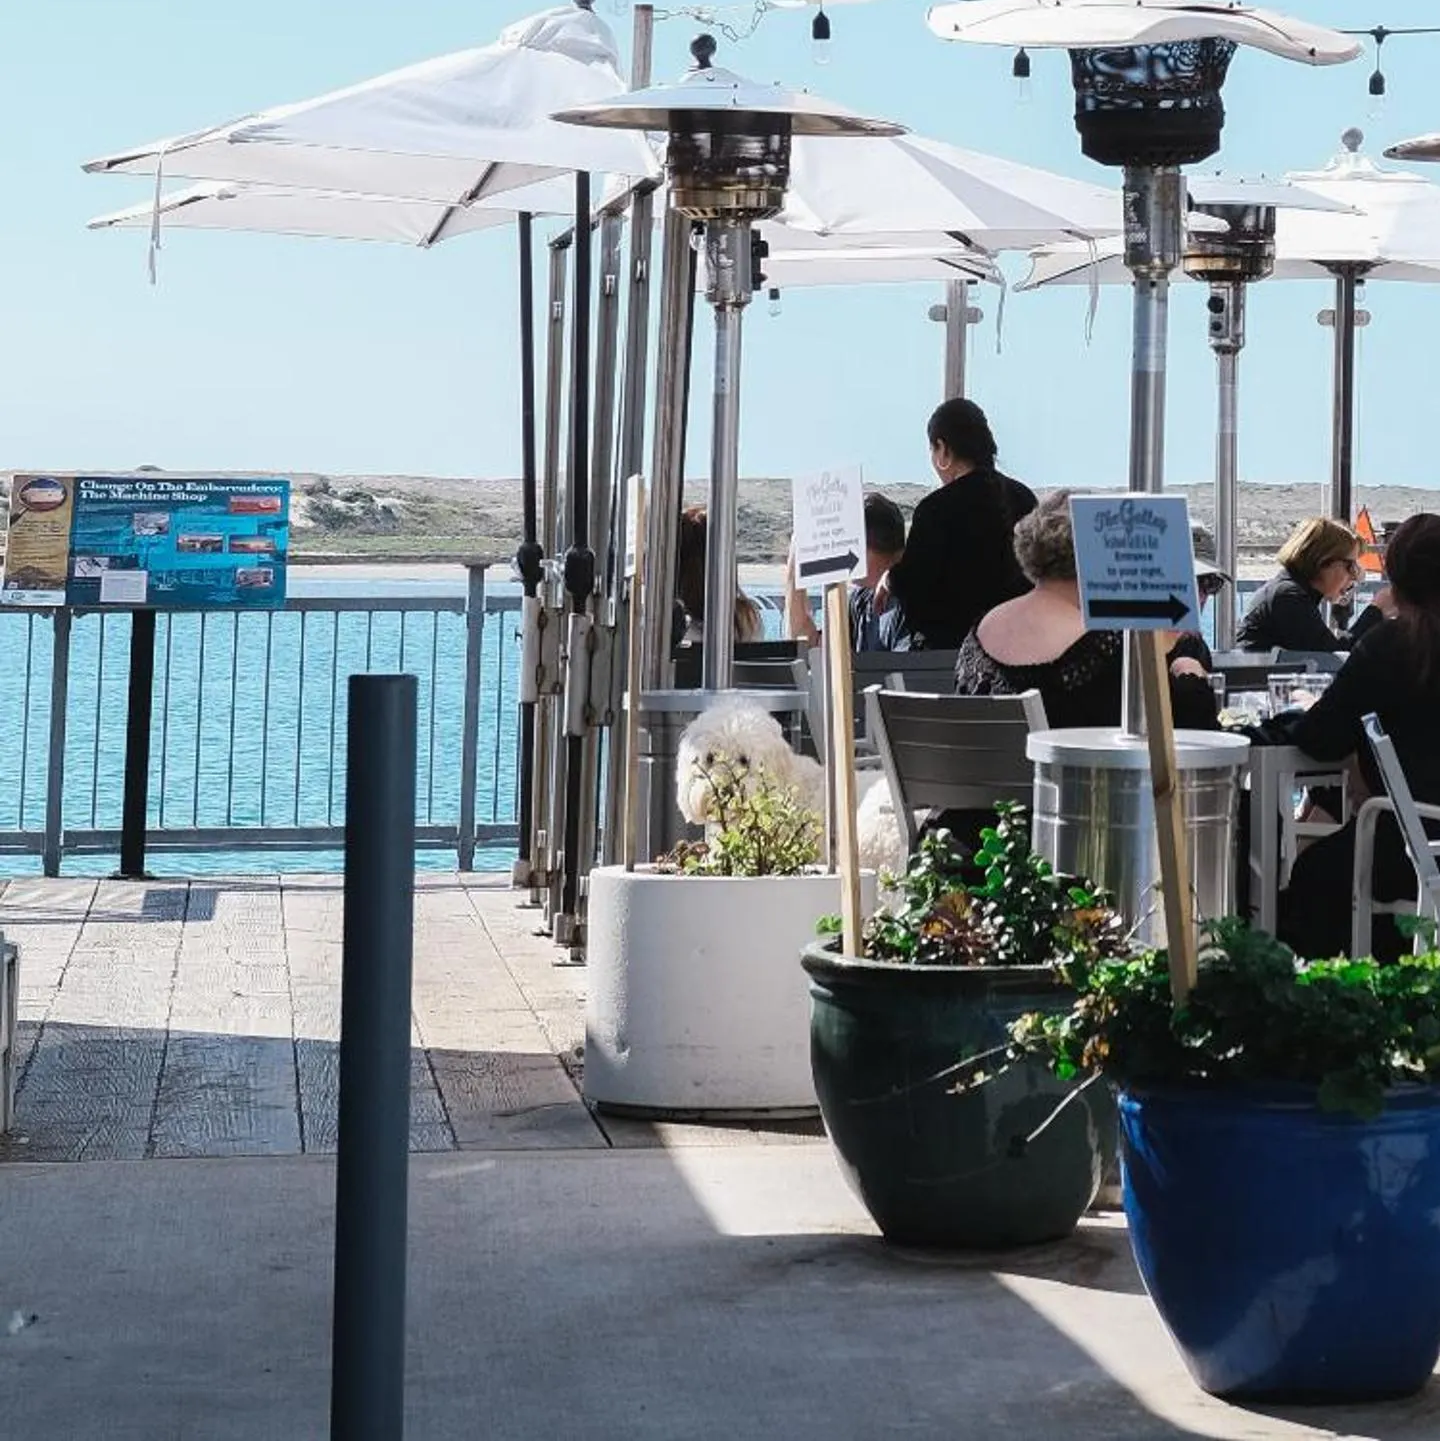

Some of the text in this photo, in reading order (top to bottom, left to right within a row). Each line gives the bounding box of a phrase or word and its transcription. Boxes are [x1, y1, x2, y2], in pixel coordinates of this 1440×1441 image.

[80, 480, 132, 493] Change
[135, 481, 155, 491] On
[158, 482, 183, 492] The
[80, 490, 208, 503] The Machine Shop
[1094, 499, 1167, 535] The Galley
[1114, 551, 1153, 561] Entrance
[1107, 567, 1117, 576] to
[1119, 568, 1138, 577] your
[1087, 581, 1122, 591] through
[1124, 581, 1138, 590] the
